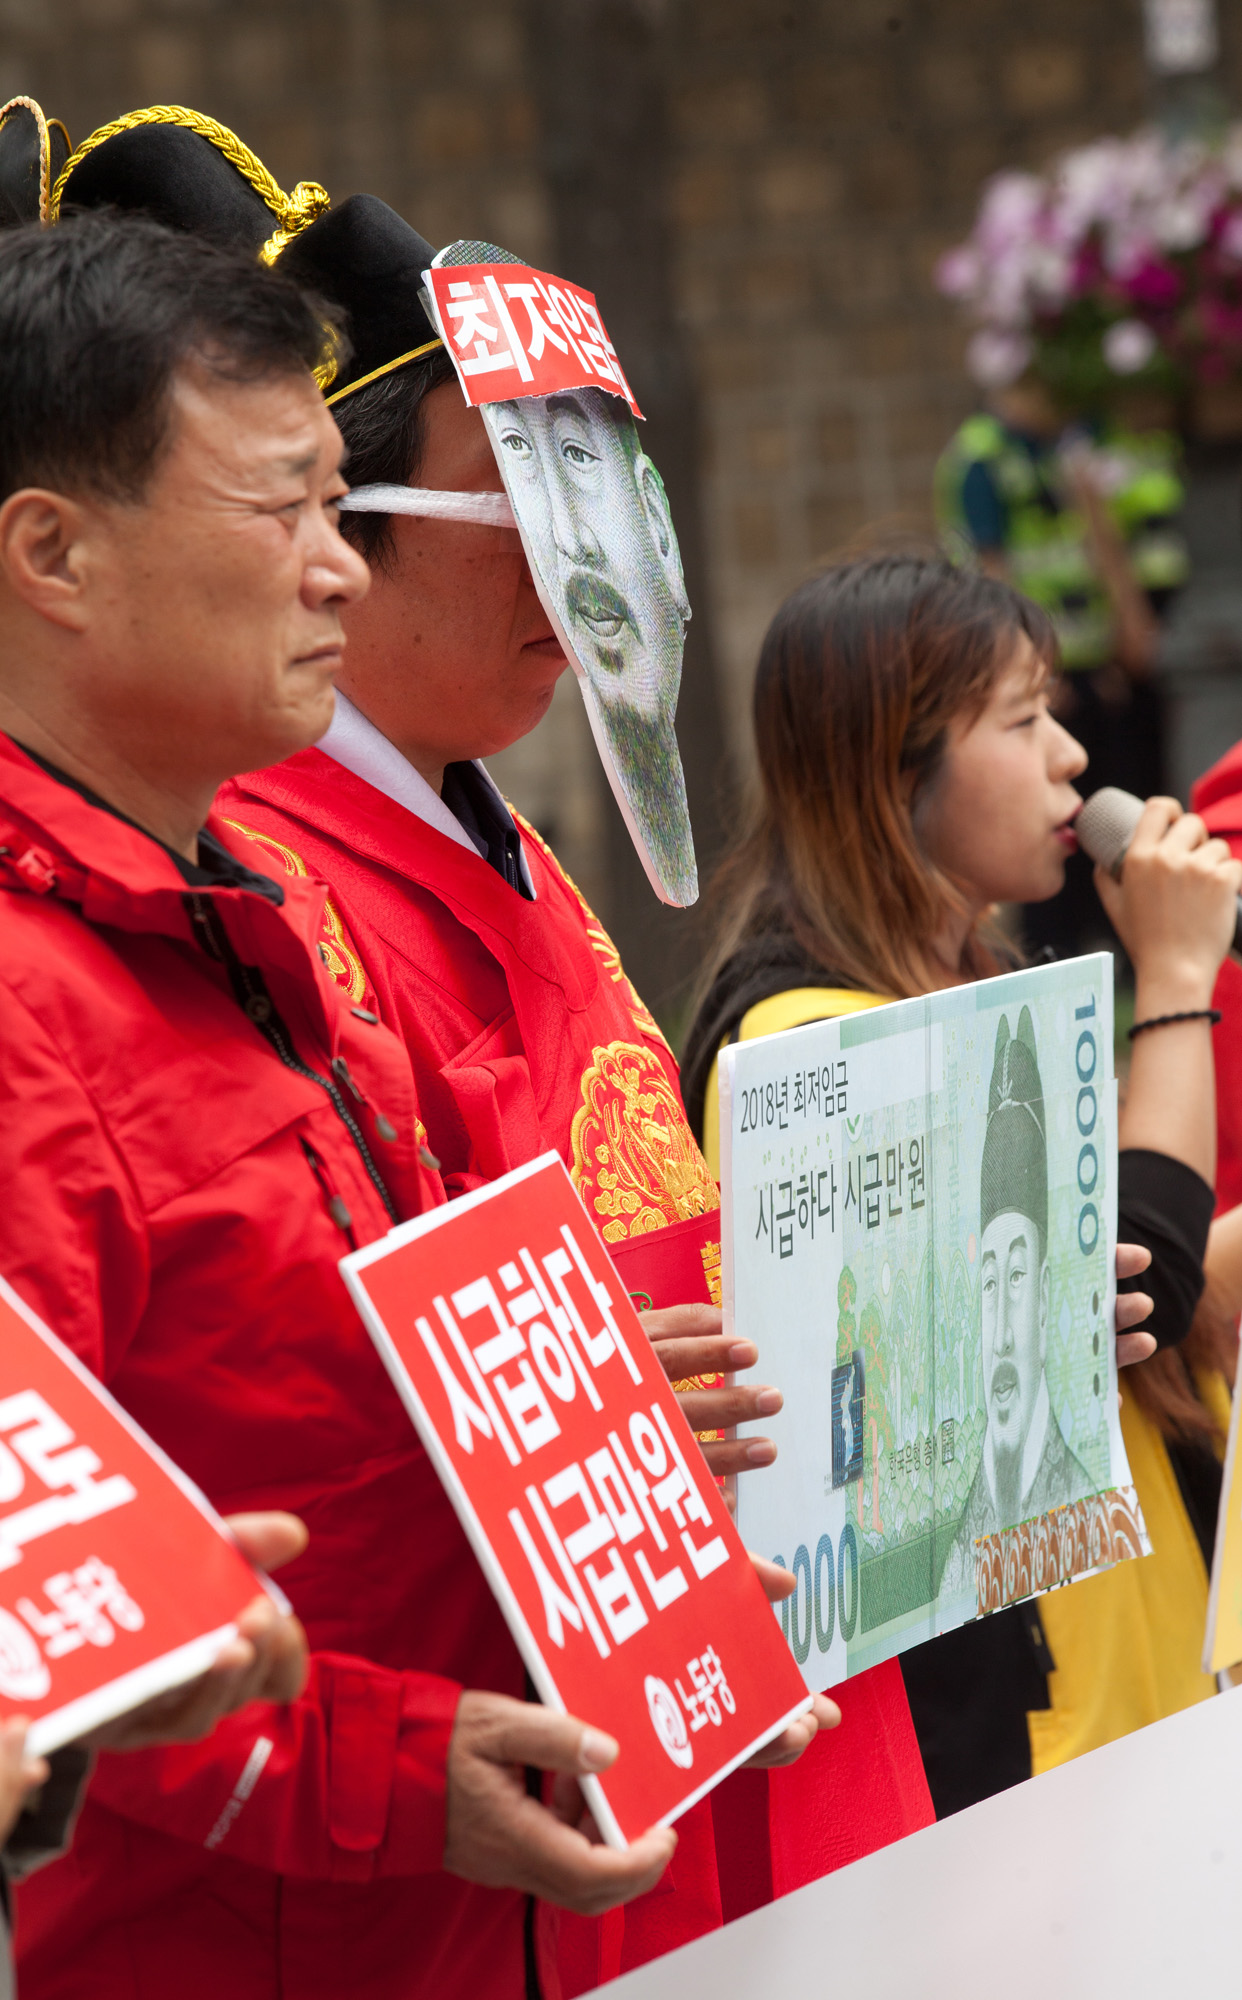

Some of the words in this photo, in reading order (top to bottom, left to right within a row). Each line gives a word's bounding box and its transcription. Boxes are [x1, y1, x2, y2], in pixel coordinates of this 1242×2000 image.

[740, 1081, 789, 1133] 2018년
[793, 1060, 849, 1118] 최저임금
[1075, 993, 1099, 1256] 10000
[755, 1163, 838, 1259] 시급하다
[844, 1135, 926, 1230] 시급만원
[414, 1224, 643, 1467] 시급하다
[507, 1402, 731, 1660] 시급만원
[15, 1555, 145, 1659] 노동당
[674, 1644, 736, 1733] 노동당
